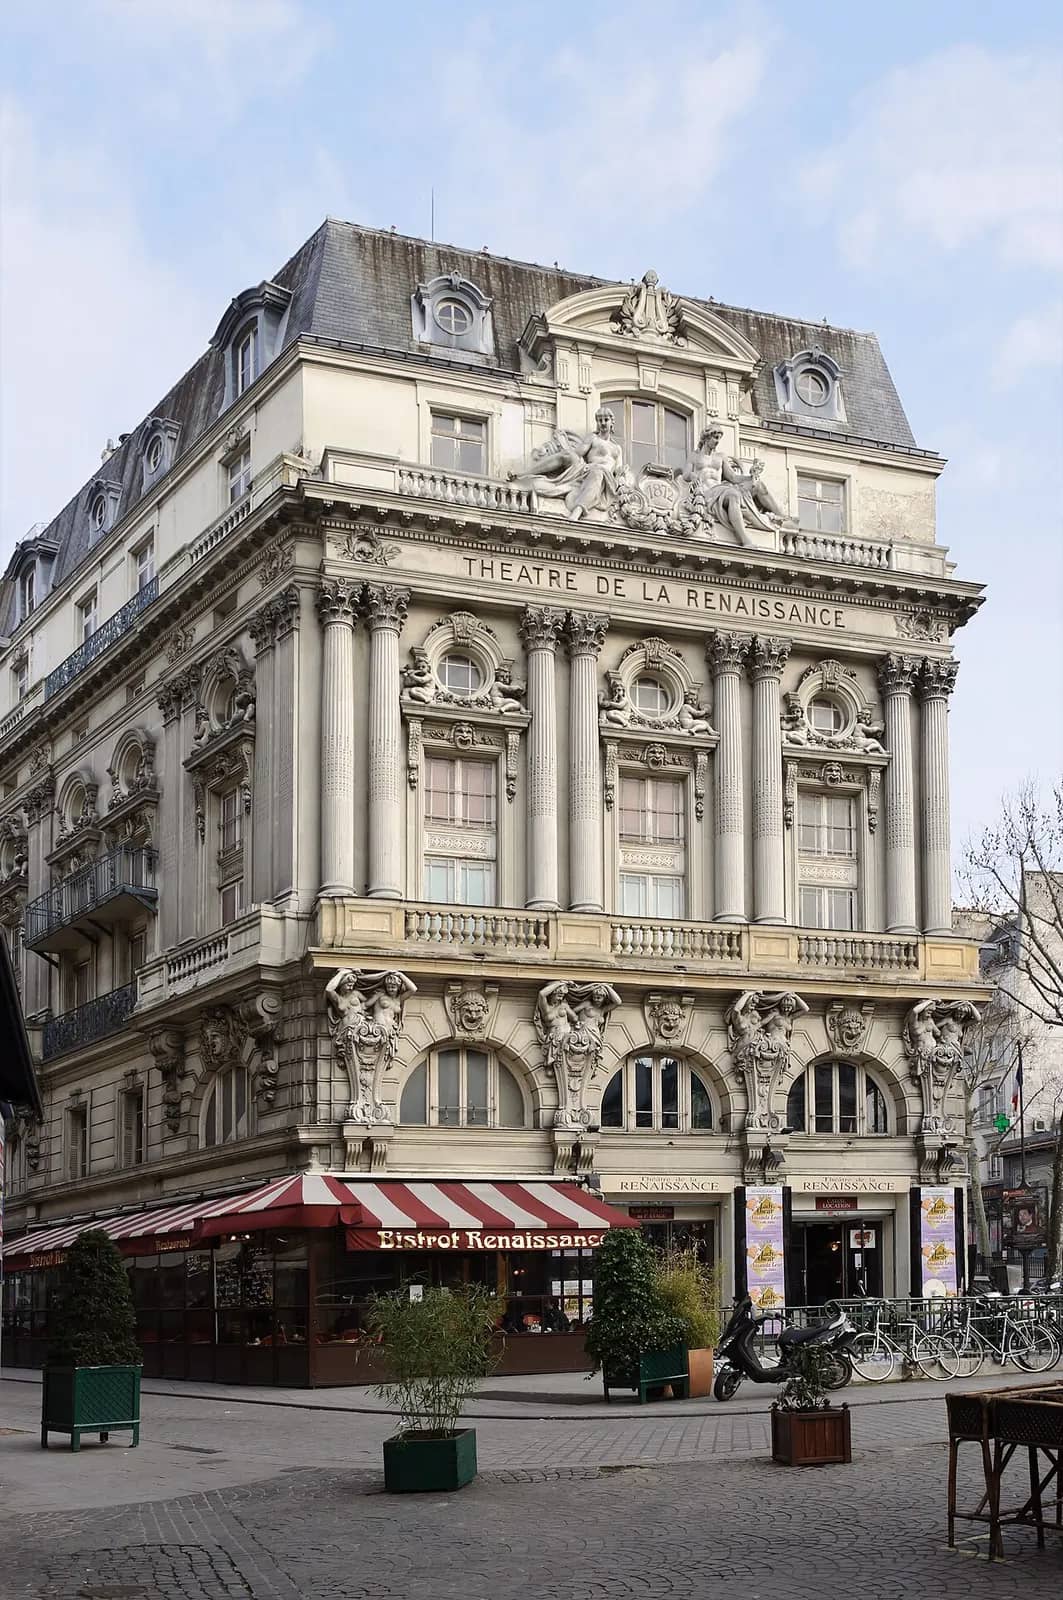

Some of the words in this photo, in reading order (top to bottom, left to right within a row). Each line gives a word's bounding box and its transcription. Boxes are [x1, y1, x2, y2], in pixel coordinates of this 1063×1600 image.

[462, 557, 578, 591] THEATRE
[597, 575, 626, 598] DE
[642, 582, 671, 604] LA
[687, 588, 846, 628] RENAISSANCE
[620, 1181, 720, 1191] RENAISSANCE
[803, 1182, 895, 1191] RENAISSANCE
[376, 1230, 460, 1249] Bistrot
